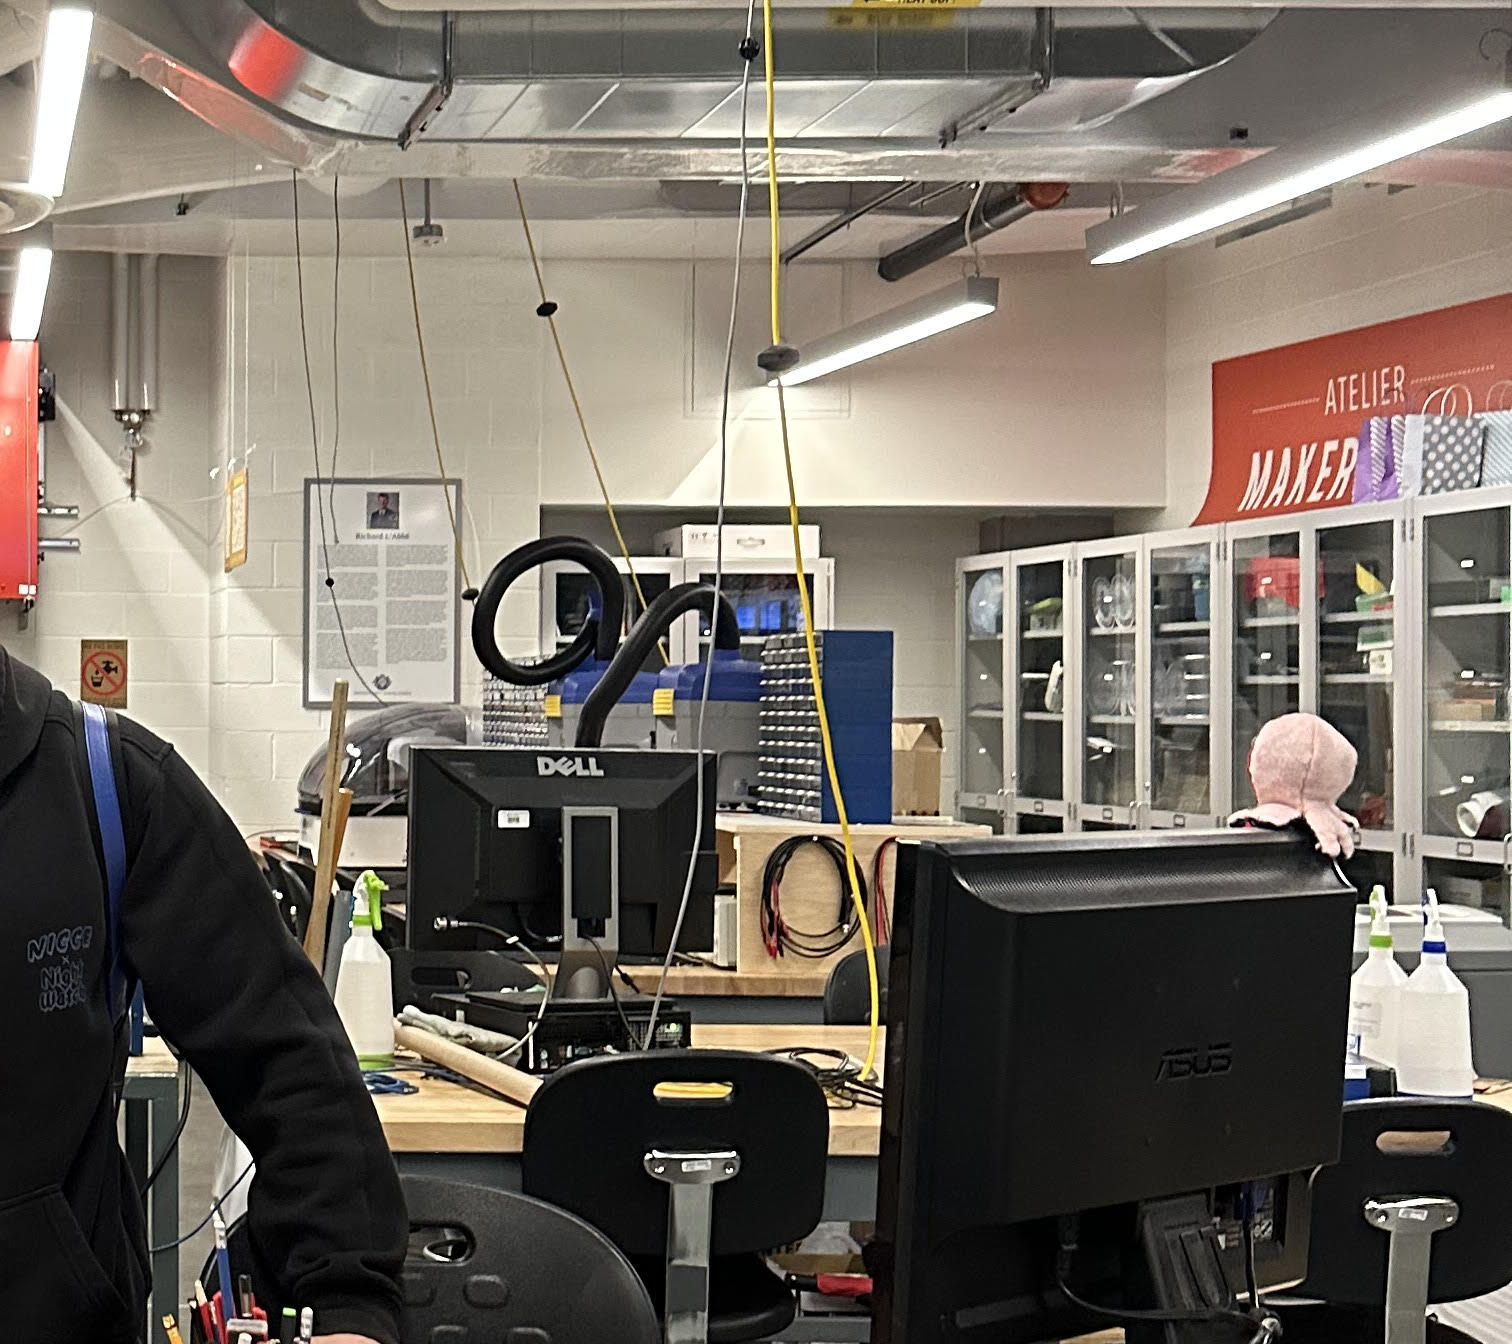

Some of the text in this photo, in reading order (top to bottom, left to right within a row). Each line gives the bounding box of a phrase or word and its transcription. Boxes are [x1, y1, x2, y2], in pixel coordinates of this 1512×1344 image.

[1324, 365, 1406, 416] ATELIER
[1237, 436, 1360, 513] MAKER
[537, 756, 604, 777] DELL
[1154, 1042, 1232, 1083] ASUS
